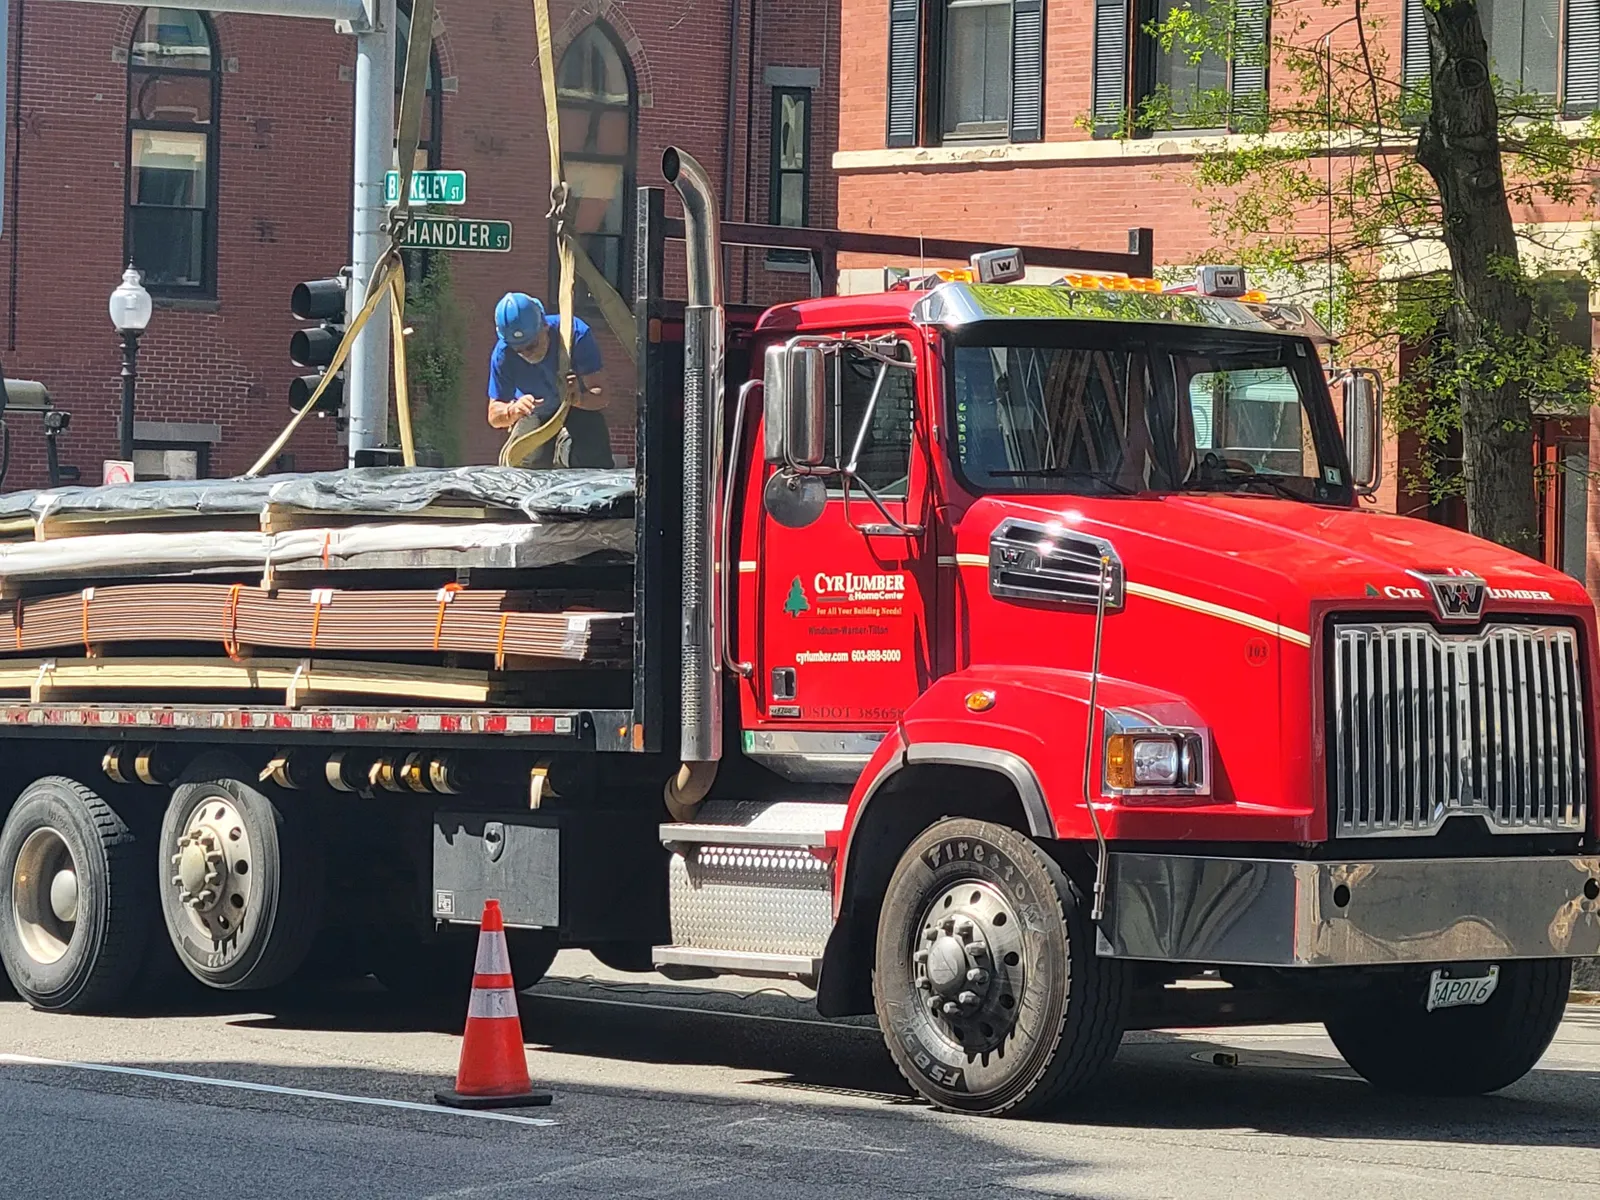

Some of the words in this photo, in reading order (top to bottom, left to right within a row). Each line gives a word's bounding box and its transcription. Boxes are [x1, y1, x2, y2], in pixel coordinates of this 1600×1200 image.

[387, 175, 448, 199] BKELEY
[451, 186, 460, 199] ST
[496, 235, 507, 248] ST
[1384, 586, 1425, 599] CYR
[1485, 586, 1555, 601] LUMBER
[816, 607, 827, 616] For
[828, 607, 837, 616] All
[838, 607, 853, 616] Your
[854, 607, 880, 617] Building
[795, 650, 849, 665] cyrlumber.com
[851, 649, 902, 662] 603-898-5000
[801, 706, 851, 719] USDOT
